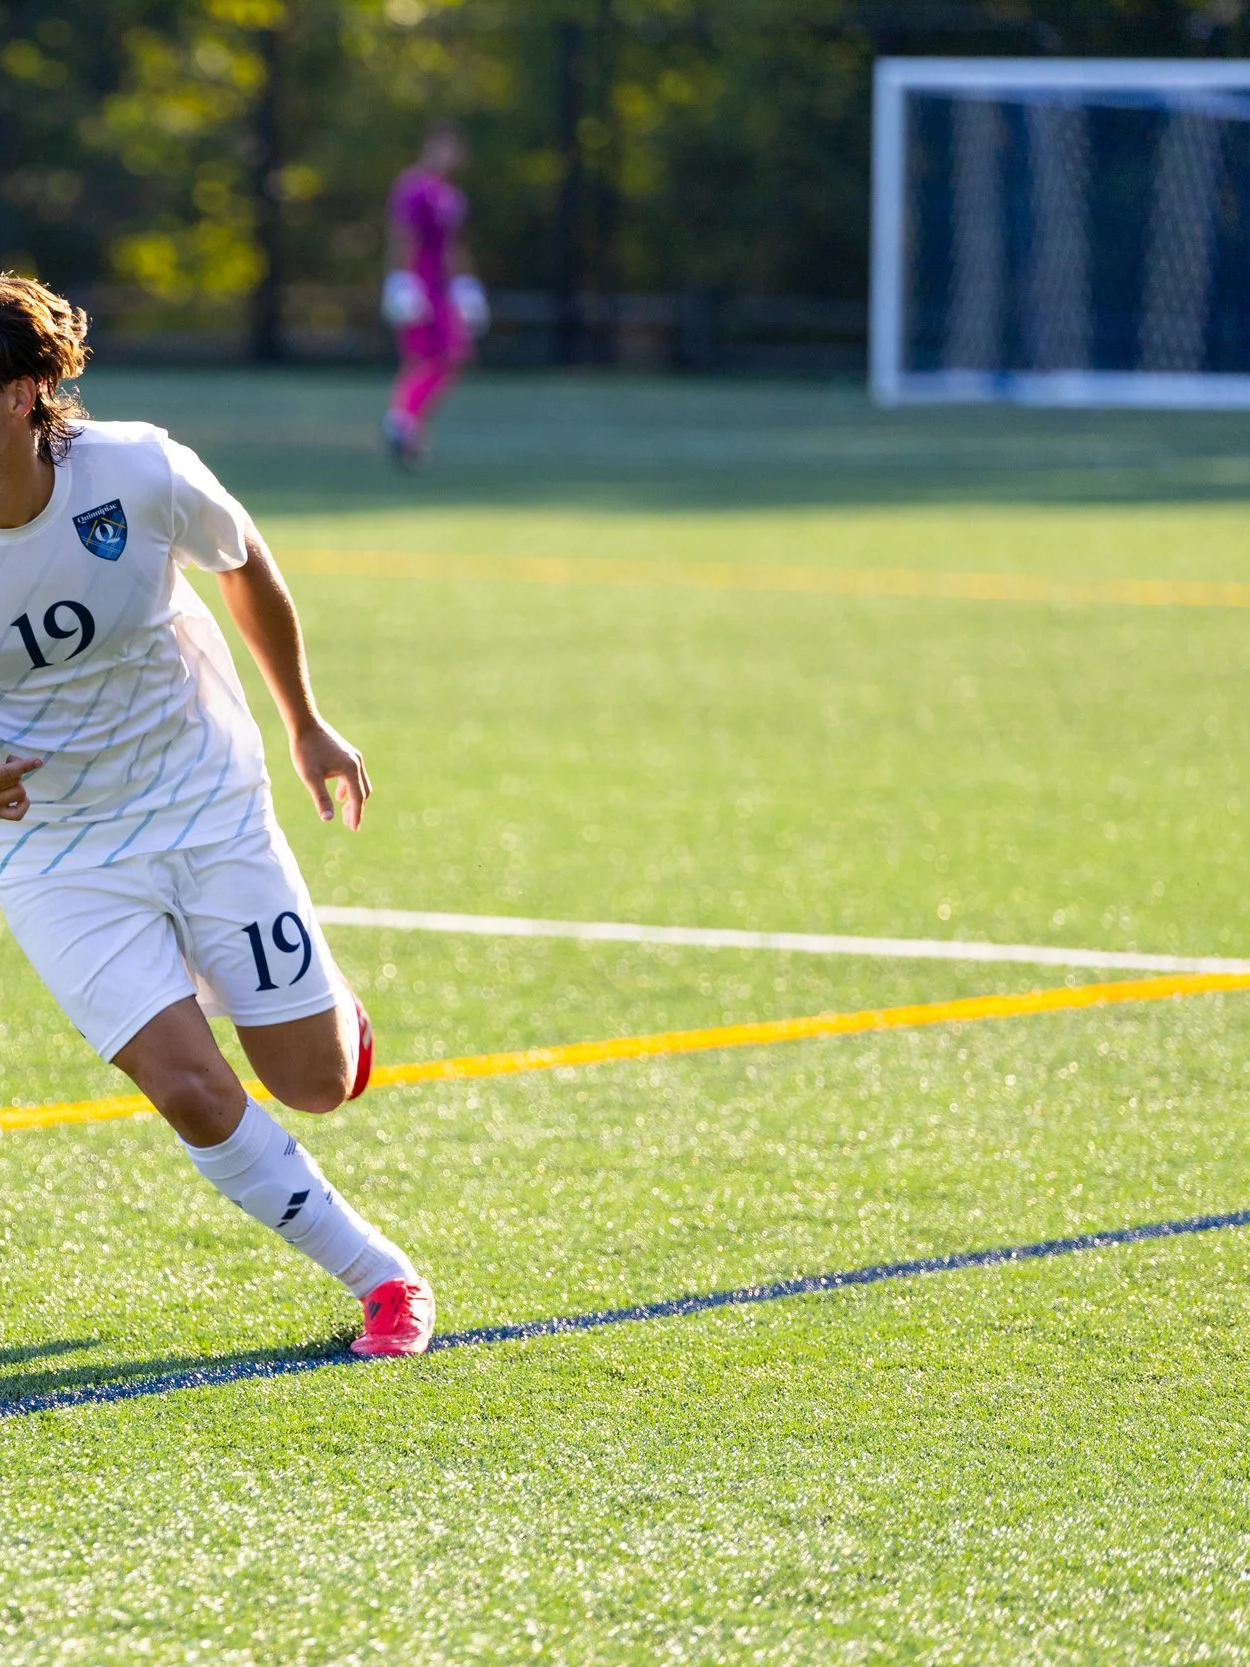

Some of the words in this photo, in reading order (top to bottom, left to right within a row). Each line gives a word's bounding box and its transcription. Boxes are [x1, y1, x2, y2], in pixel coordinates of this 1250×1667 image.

[95, 523, 120, 544] Q
[10, 600, 95, 670] 19
[241, 911, 311, 991] 19
